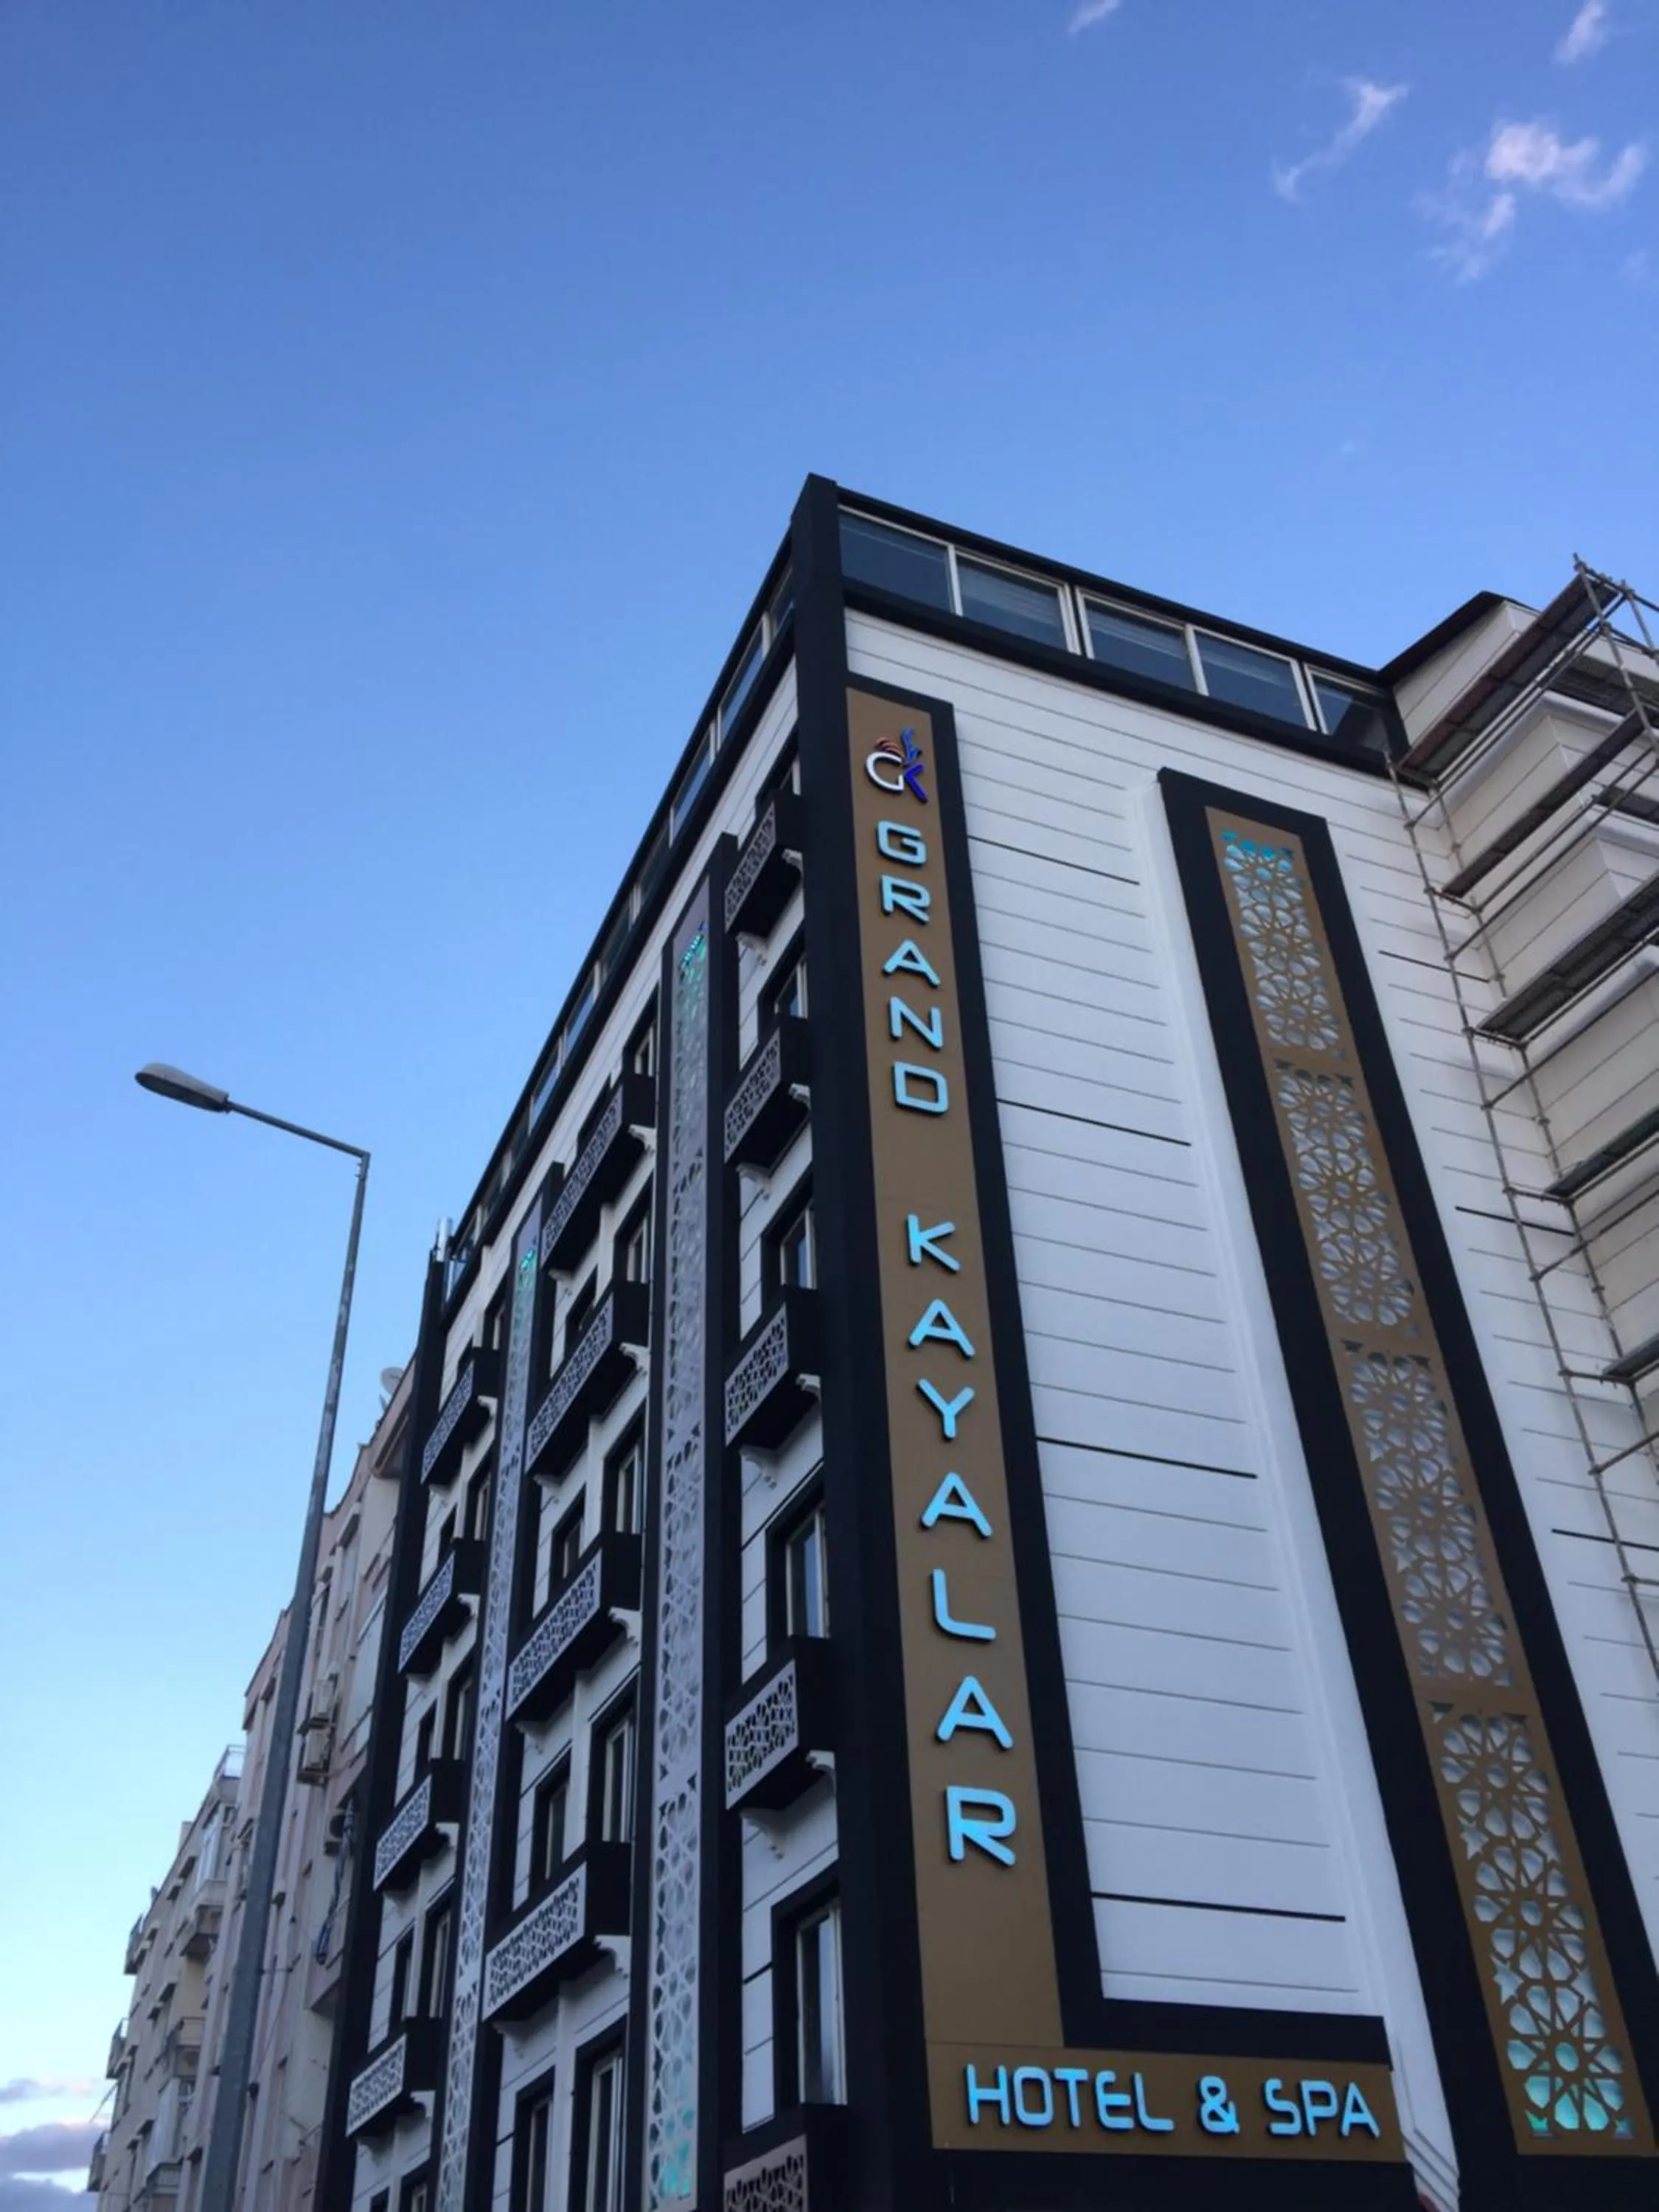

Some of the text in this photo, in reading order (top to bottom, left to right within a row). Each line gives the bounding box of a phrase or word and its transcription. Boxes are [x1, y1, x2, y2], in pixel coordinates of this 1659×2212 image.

[877, 819, 1016, 1866] GRAND KAYALAR
[965, 2064, 1380, 2138] HOTEL & SPA
